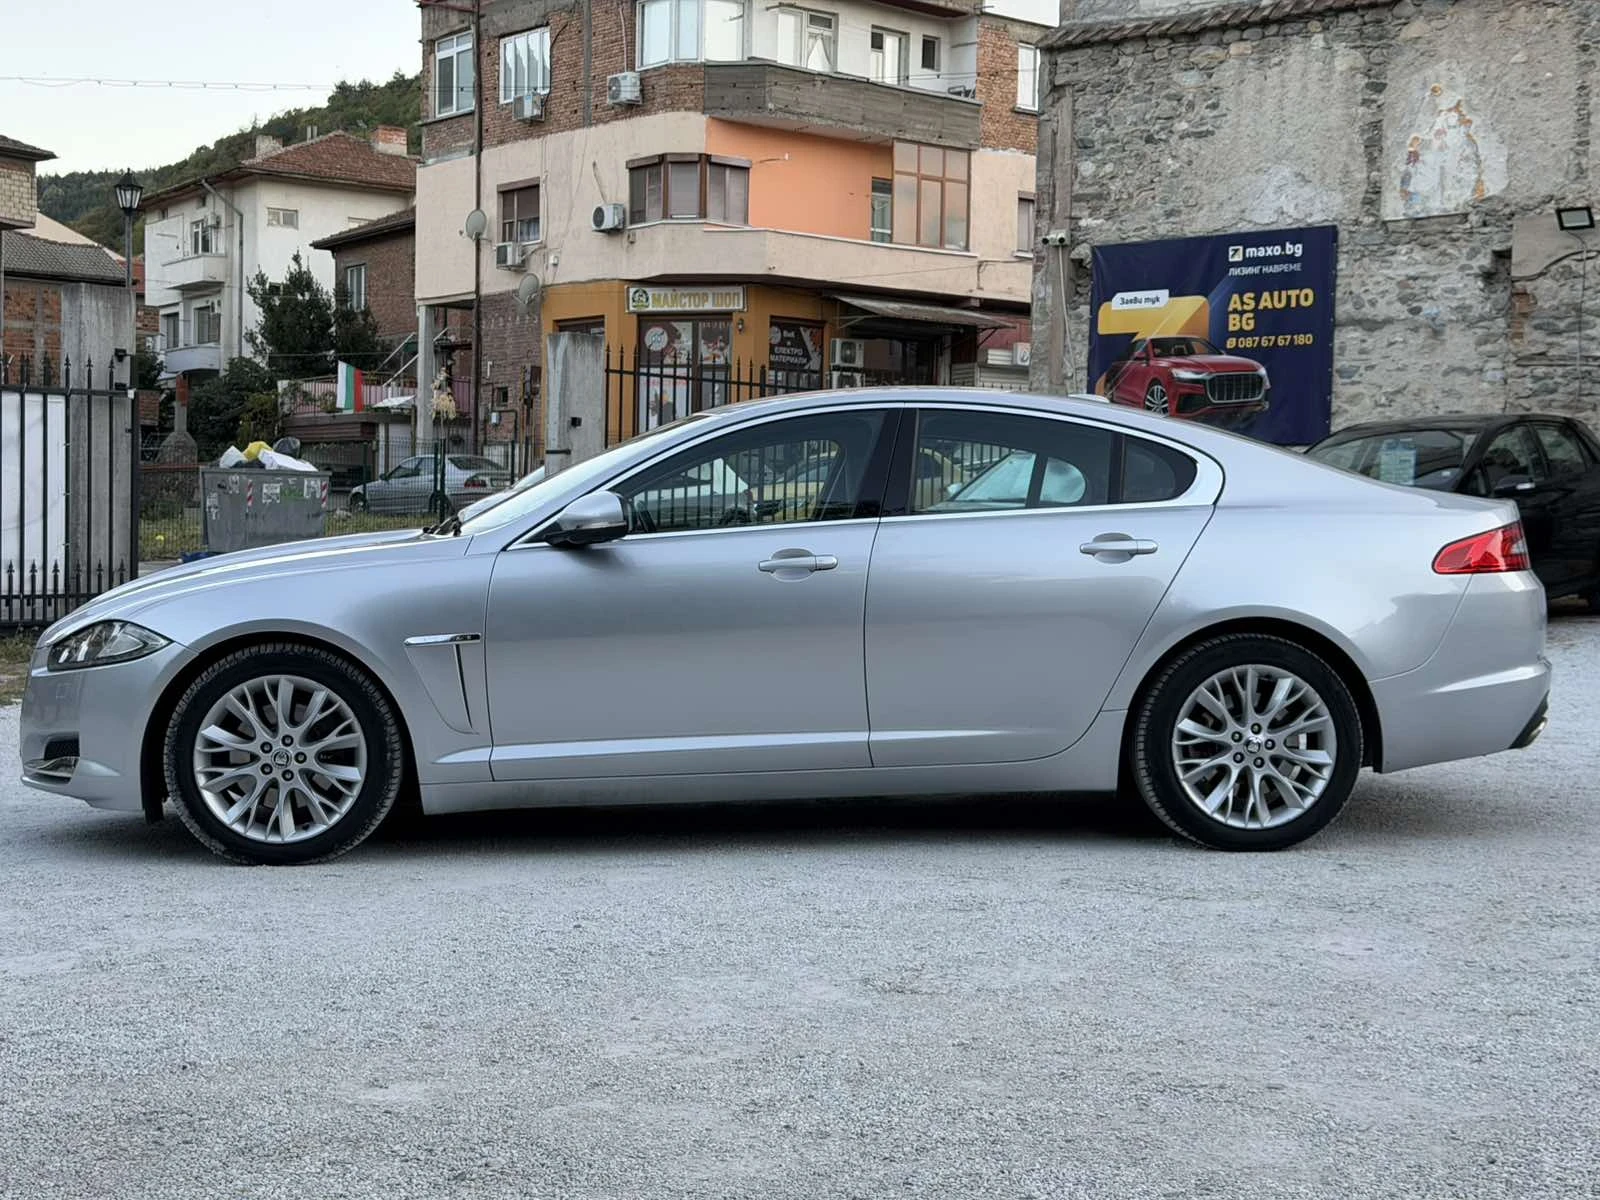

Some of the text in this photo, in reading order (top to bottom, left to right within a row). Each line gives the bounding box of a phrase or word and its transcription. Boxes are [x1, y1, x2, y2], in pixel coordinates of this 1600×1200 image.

[1245, 241, 1303, 258] maxo.bg
[1229, 263, 1302, 276] ЛИЗИНГ НАВРЕМЕ
[651, 288, 741, 309] МАЙСТОР ШОП
[1143, 296, 1161, 305] тук
[1228, 288, 1314, 312] AS AUTO
[1228, 312, 1255, 332] BG
[1238, 334, 1314, 348] 087 67 67 180
